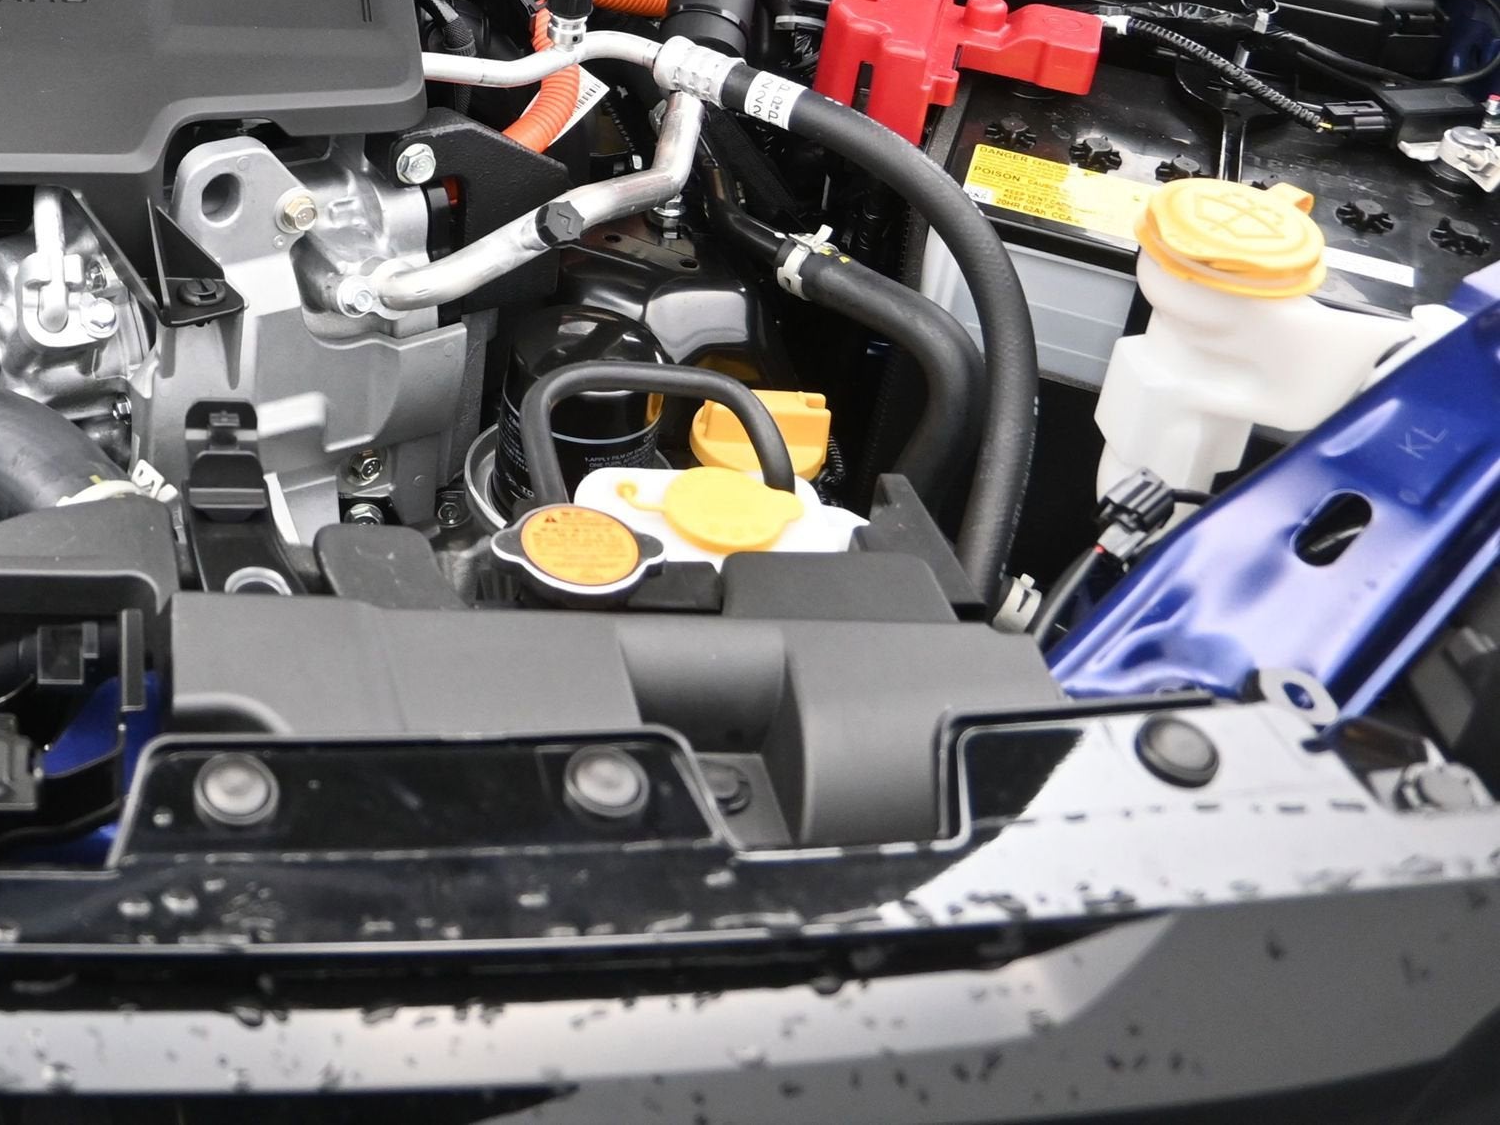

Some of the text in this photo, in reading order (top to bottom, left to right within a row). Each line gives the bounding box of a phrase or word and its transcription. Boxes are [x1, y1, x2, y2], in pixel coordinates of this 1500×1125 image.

[979, 146, 1028, 163] DANGER
[973, 165, 1021, 183] POISON
[1395, 425, 1450, 461] KL
